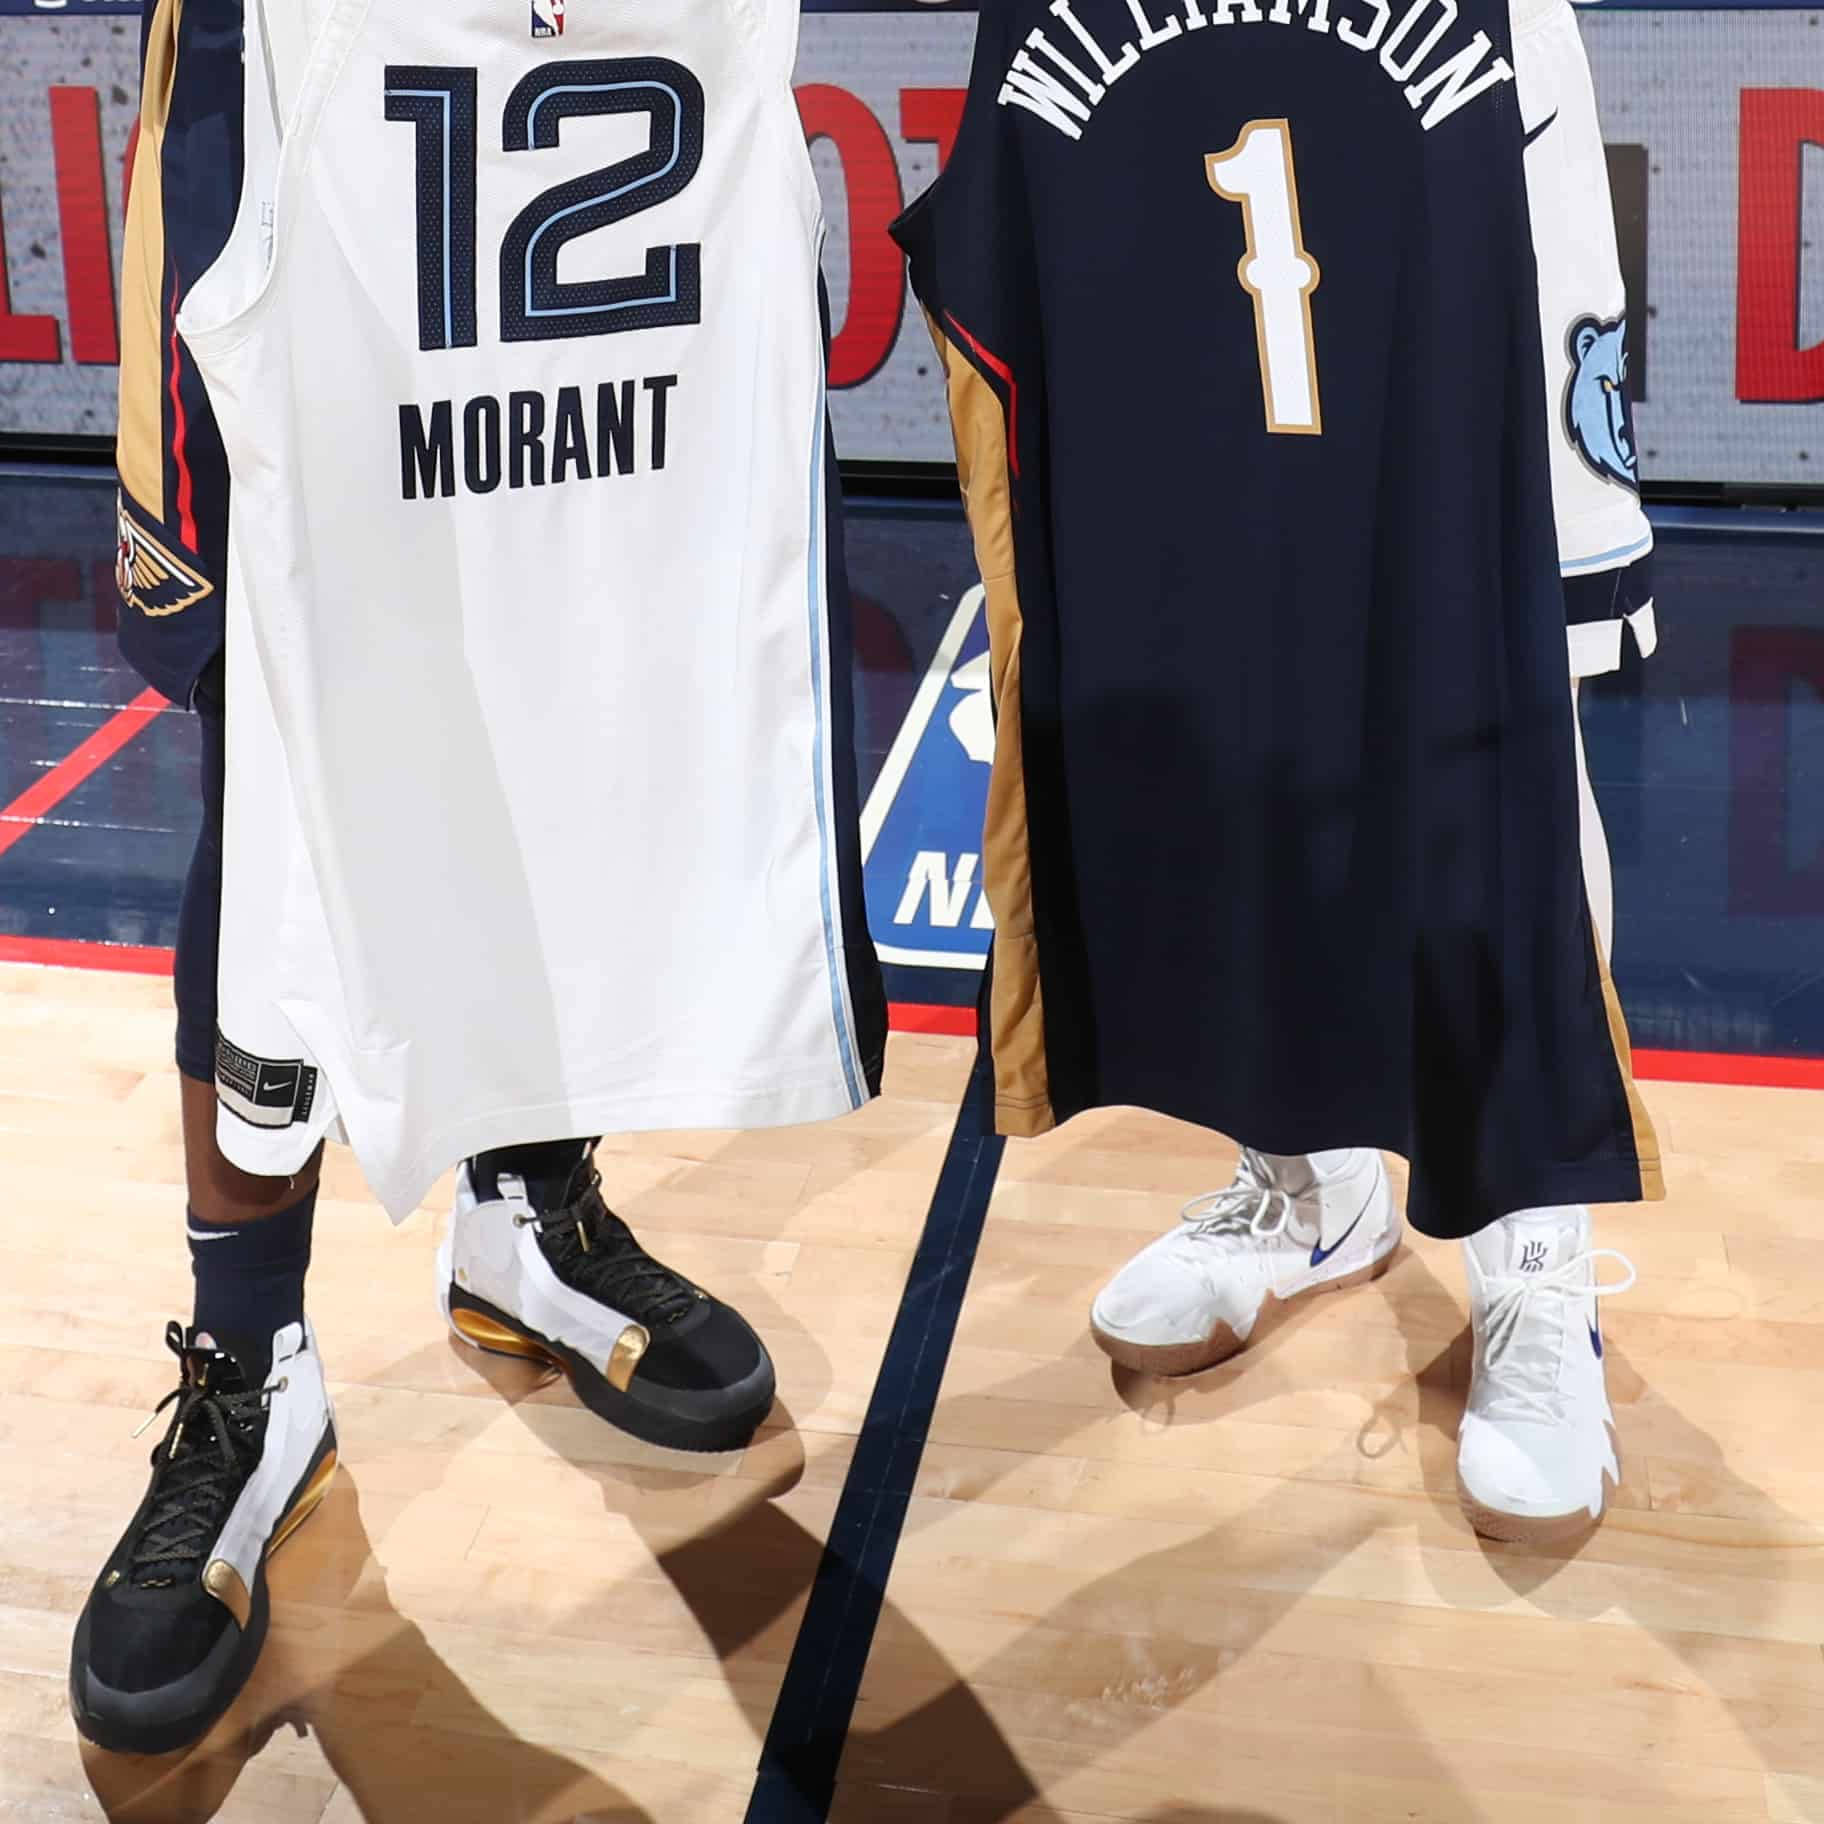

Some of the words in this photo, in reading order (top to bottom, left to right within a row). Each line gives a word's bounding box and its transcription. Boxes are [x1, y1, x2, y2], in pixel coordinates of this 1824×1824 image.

[384, 56, 705, 350] 12
[1204, 118, 1322, 434] 1
[399, 374, 678, 500] MORANT
